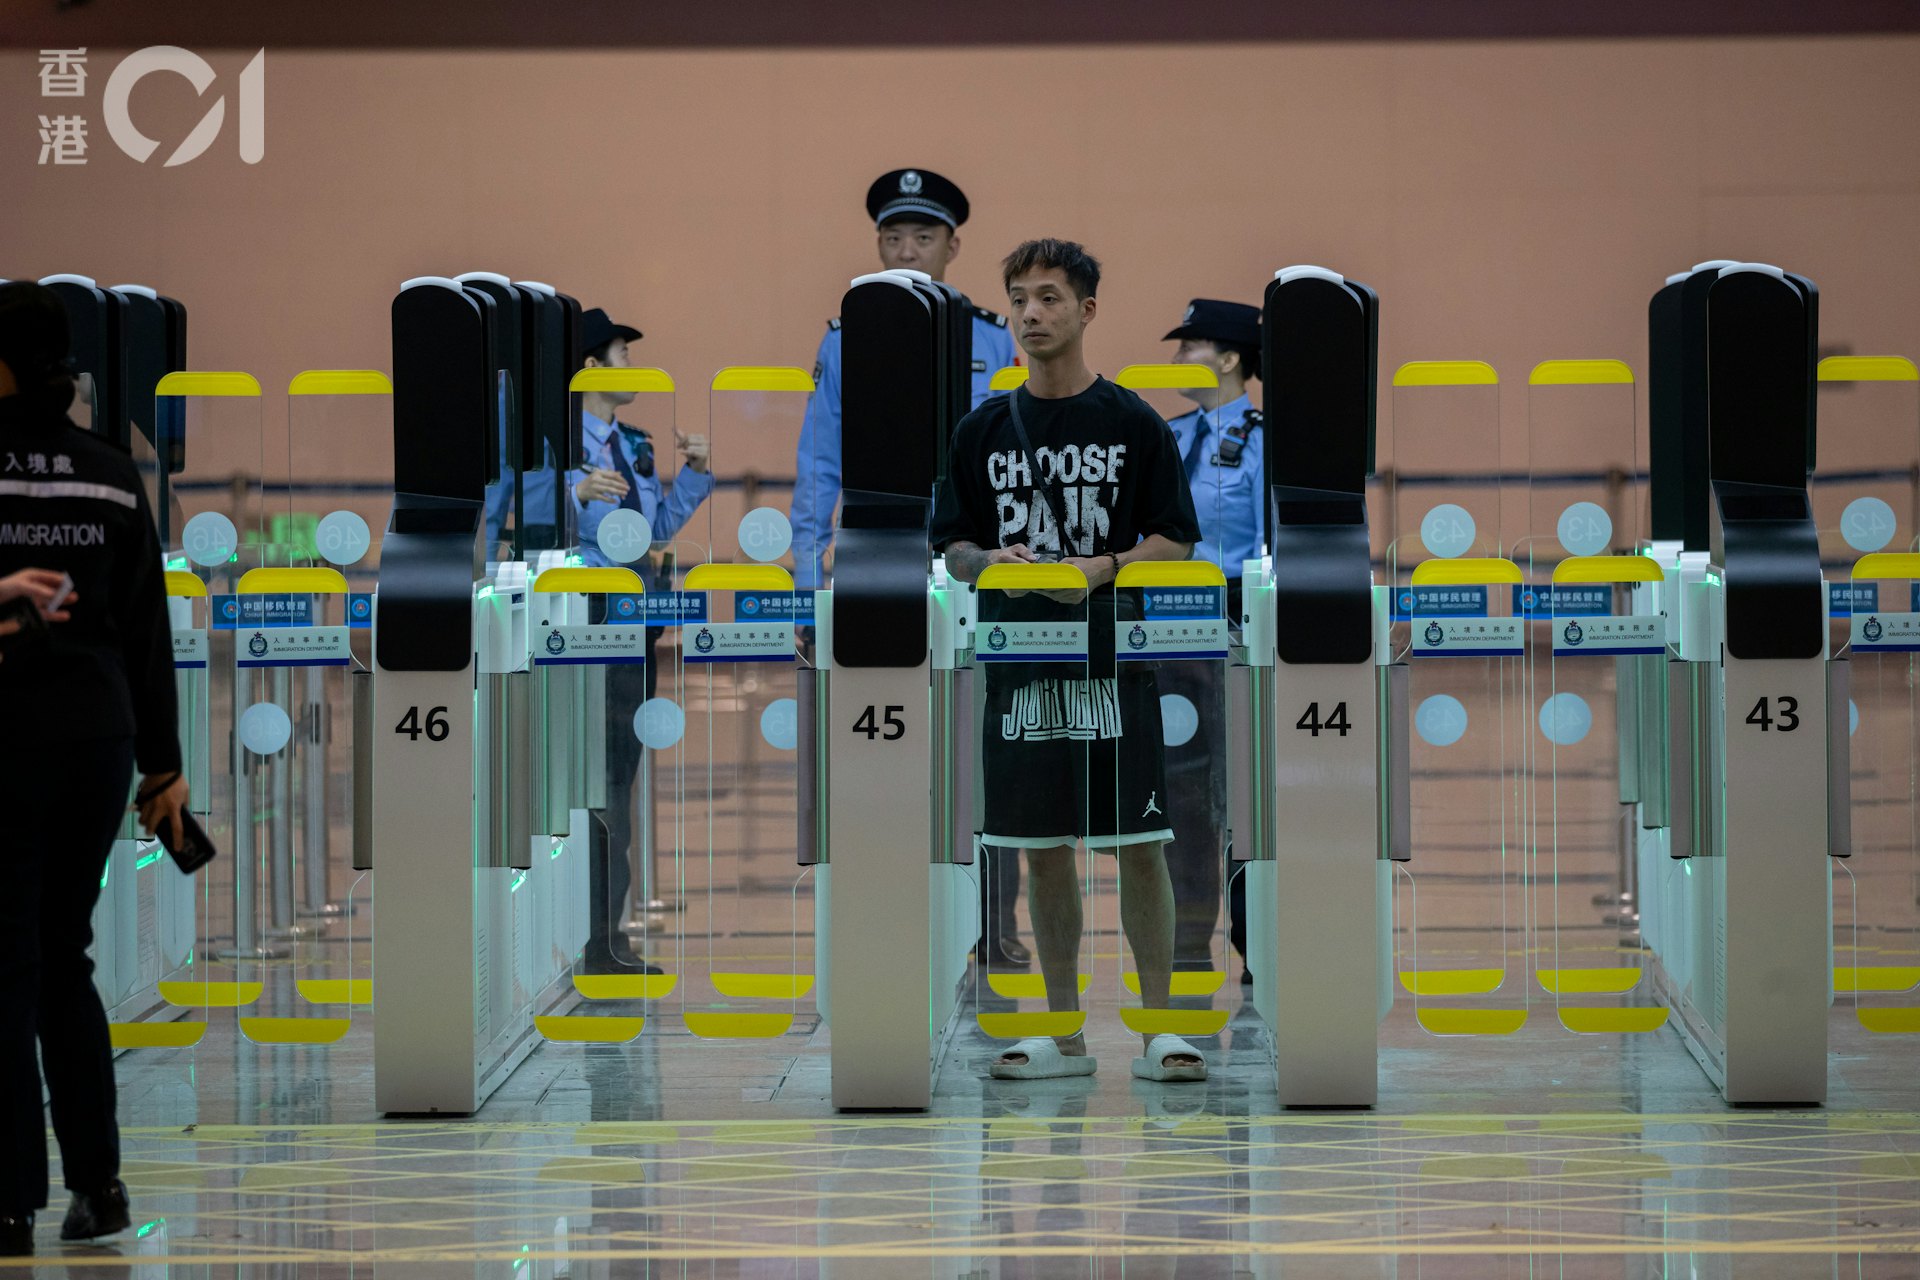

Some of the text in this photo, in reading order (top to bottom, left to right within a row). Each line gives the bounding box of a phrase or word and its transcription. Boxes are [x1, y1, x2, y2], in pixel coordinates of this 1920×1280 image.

[4, 452, 75, 474] 入境處
[988, 444, 1127, 490] CHOOSE
[761, 597, 814, 607] 中国移民管
[1152, 594, 1215, 604] 中国移民管理
[1418, 592, 1481, 603] 中国移民管理
[1539, 592, 1604, 602] 中国移民管理
[243, 600, 307, 612] 中国移民管理
[637, 598, 701, 608] 中国移民管理
[1152, 628, 1218, 636] 入境事務處
[1588, 624, 1655, 632] 入境事務處
[273, 636, 339, 644] 入境事務處
[570, 634, 636, 642] 入境事務處
[719, 632, 785, 640] 入境事務處
[1745, 696, 1800, 732] 43
[395, 706, 449, 741] 46
[852, 705, 905, 740] 45
[1296, 702, 1352, 737] 44
